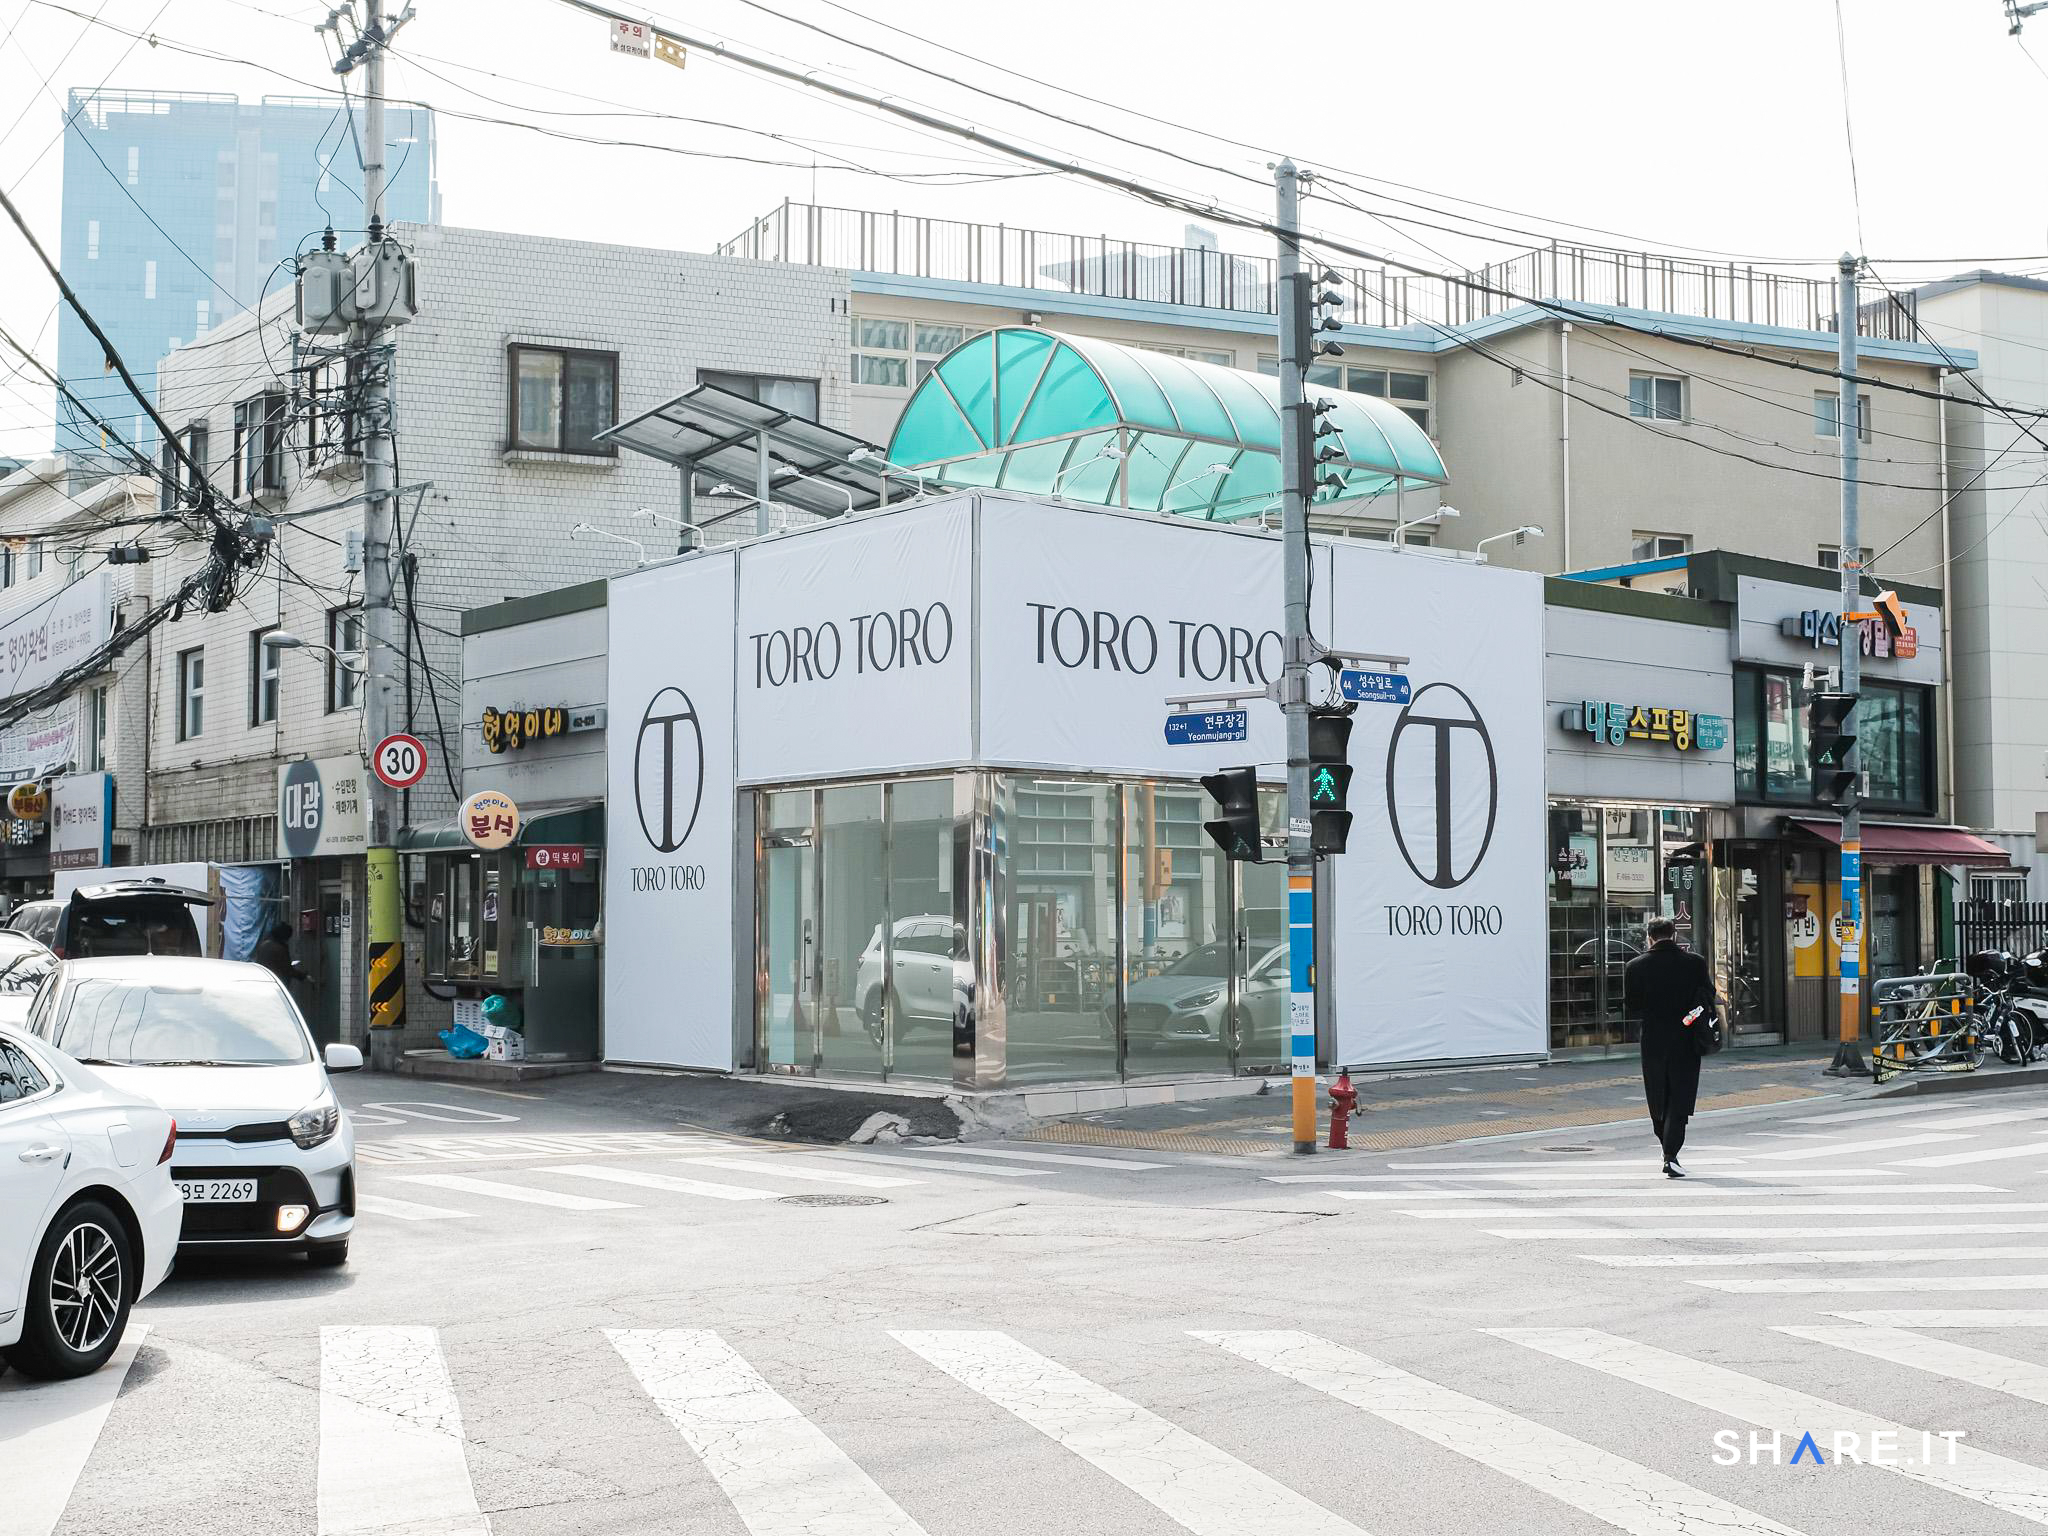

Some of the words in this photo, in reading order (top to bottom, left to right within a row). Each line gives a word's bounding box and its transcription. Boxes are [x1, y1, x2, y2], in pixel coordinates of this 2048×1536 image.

[620, 22, 642, 38] 주의
[749, 621, 841, 689] TORO
[849, 601, 953, 674] TORO
[1026, 602, 1158, 675] TORO
[1168, 620, 1286, 685] TORO
[1800, 609, 1889, 658] 마스정밀
[8, 625, 49, 674] 영어학원
[1343, 680, 1352, 690] 44
[1359, 674, 1393, 690] 성수일로
[1400, 684, 1409, 695] 40
[1357, 689, 1397, 701] Seongsuil-ro
[482, 706, 563, 753] 현영이네
[1168, 723, 1180, 731] 132
[1204, 713, 1245, 730] 연무장길
[1583, 700, 1690, 751] 대동스프링
[1187, 729, 1245, 741] Yeonmujang-gil
[386, 747, 415, 775] 30
[285, 781, 320, 829] 대광
[474, 798, 508, 811] 현영이네
[471, 814, 514, 839] 분식
[552, 852, 580, 864] 떡볶이
[1613, 847, 1648, 863] 전문업체
[631, 866, 666, 891] TORO
[668, 864, 705, 891] TORO
[1668, 865, 1695, 889] 대동
[1384, 905, 1442, 936] TORO
[1447, 905, 1503, 936] TORO
[174, 1182, 205, 1200] 8모
[210, 1182, 253, 1200] 2269
